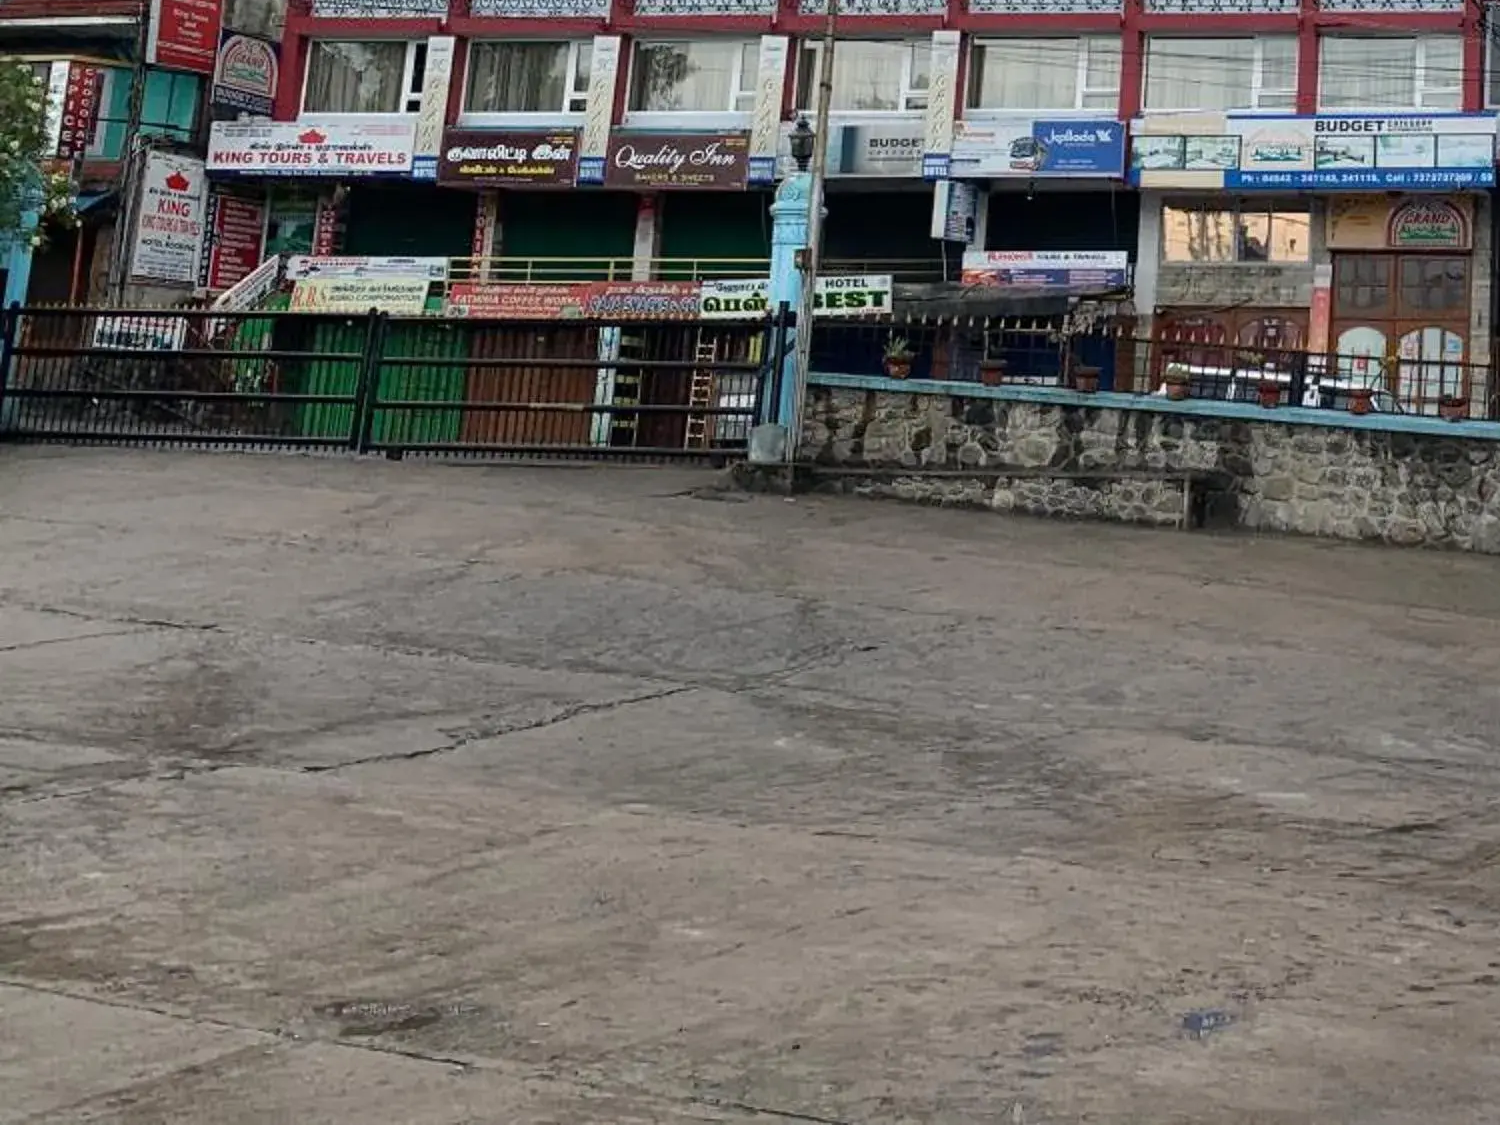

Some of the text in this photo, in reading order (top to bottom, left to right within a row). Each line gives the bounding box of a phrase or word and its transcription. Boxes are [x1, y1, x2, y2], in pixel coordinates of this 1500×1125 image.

[1315, 120, 1386, 133] BUDGET
[213, 152, 407, 166] KING TOURS & TRAVELS
[615, 142, 737, 174] Quality Inn
[158, 198, 191, 217] KING
[1404, 214, 1450, 225] GRAND
[825, 278, 869, 289] HOTEL
